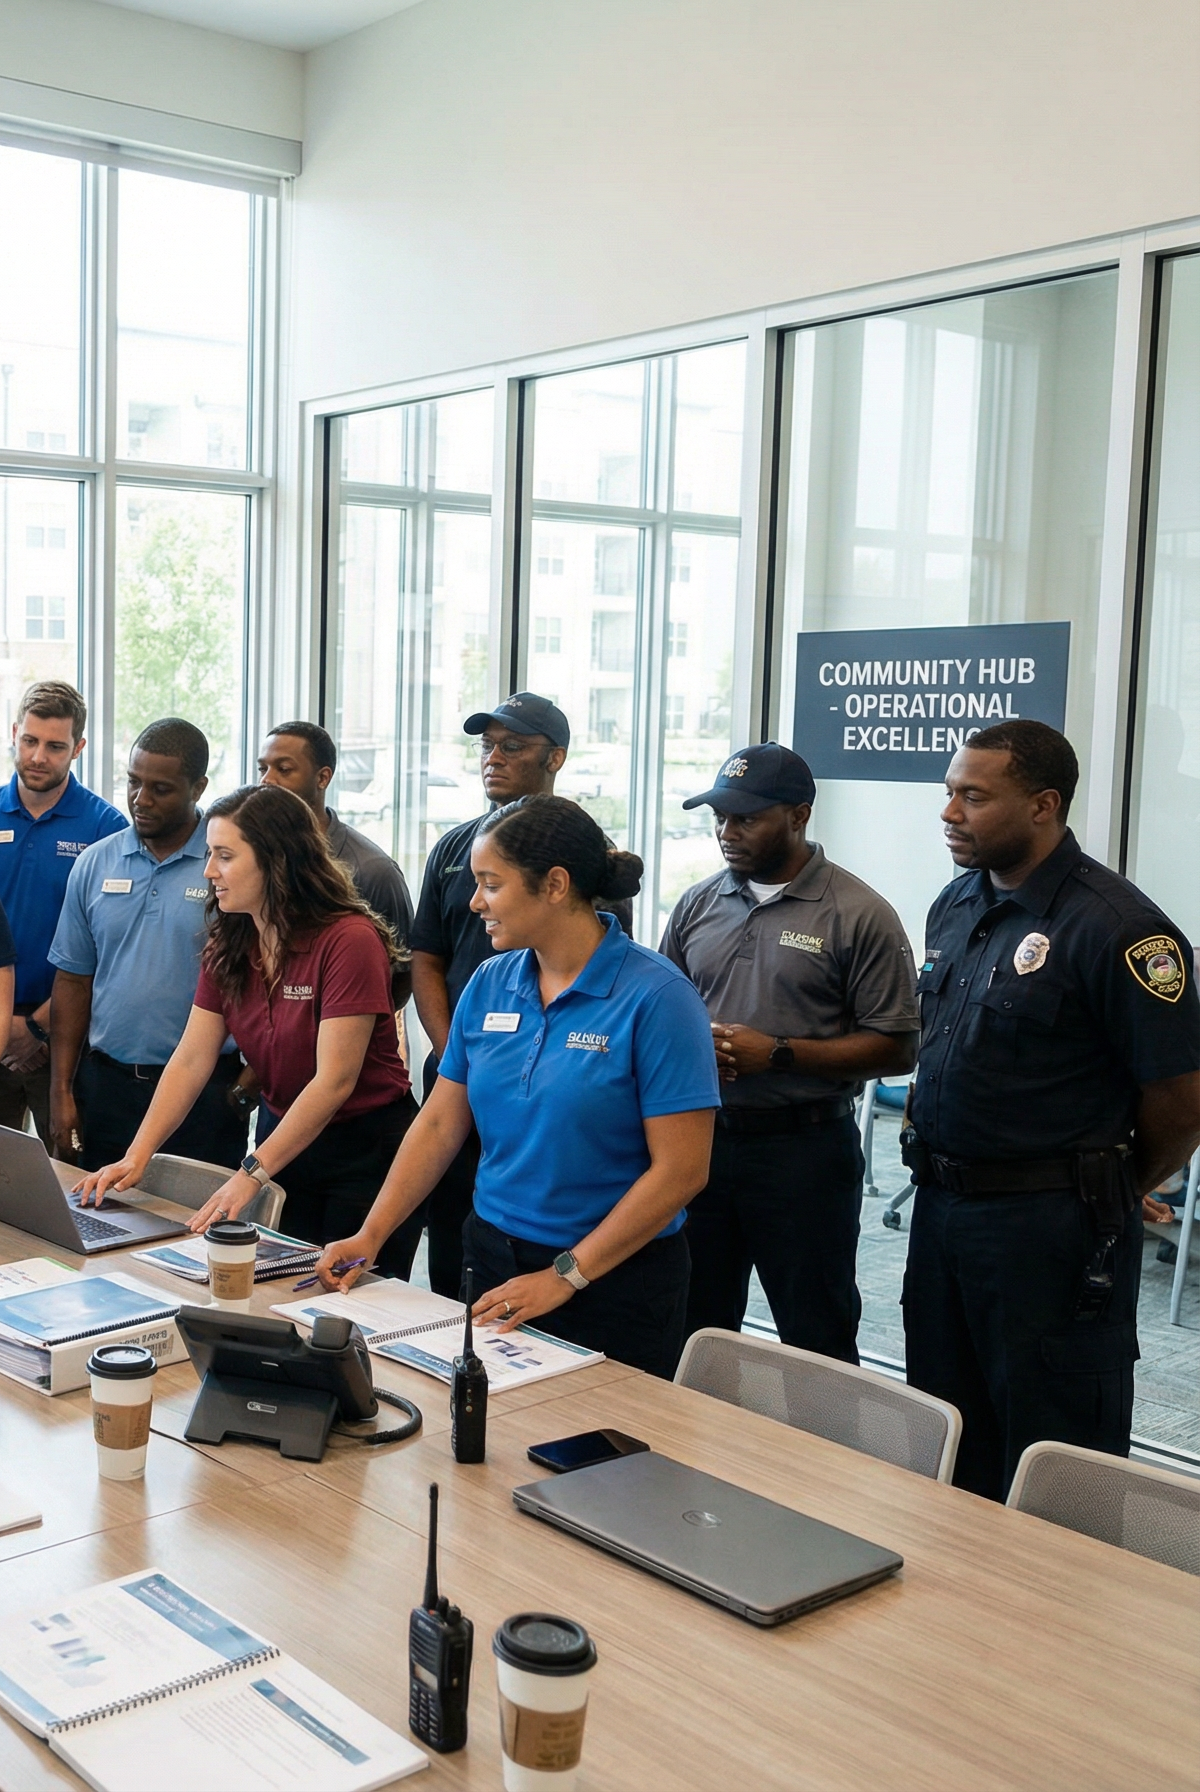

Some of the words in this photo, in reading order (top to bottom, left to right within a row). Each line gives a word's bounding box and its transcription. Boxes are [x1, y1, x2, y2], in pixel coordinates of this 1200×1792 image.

[818, 658, 972, 687] COMMUNITY
[977, 657, 1036, 685] HUB
[844, 692, 1020, 720] OPERATIONAL
[843, 726, 982, 752] EXCELLEN
